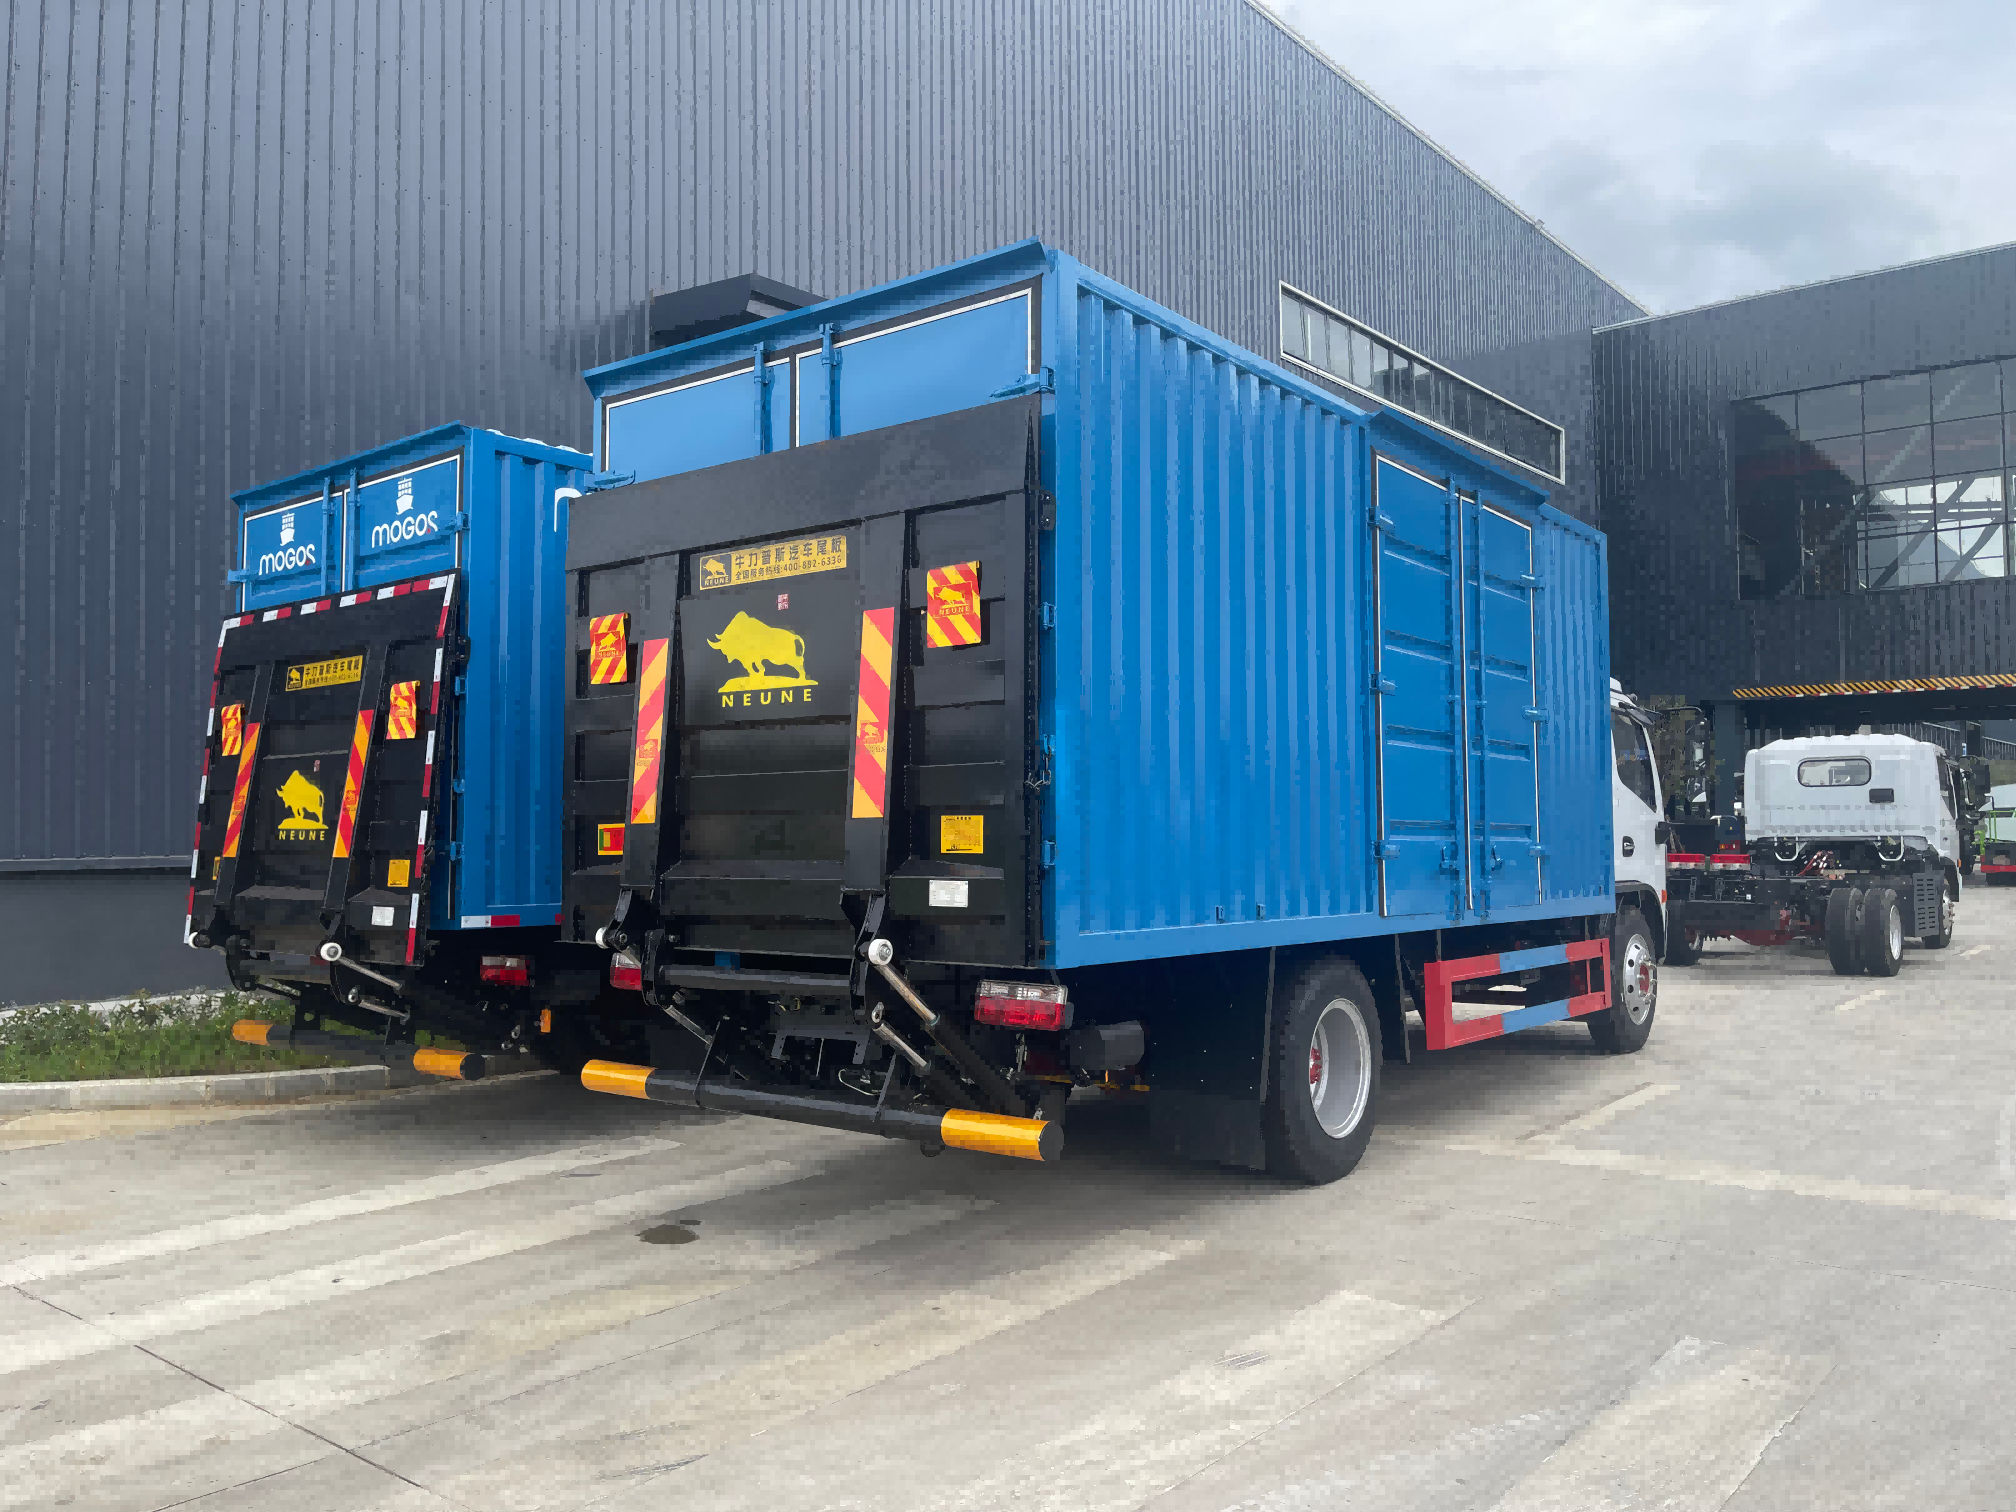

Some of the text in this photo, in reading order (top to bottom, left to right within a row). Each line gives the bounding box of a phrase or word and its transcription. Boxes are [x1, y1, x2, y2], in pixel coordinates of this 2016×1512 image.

[939, 606, 970, 616] NEUNE
[722, 688, 812, 708] NEUNE
[279, 830, 325, 841] NEUNE
